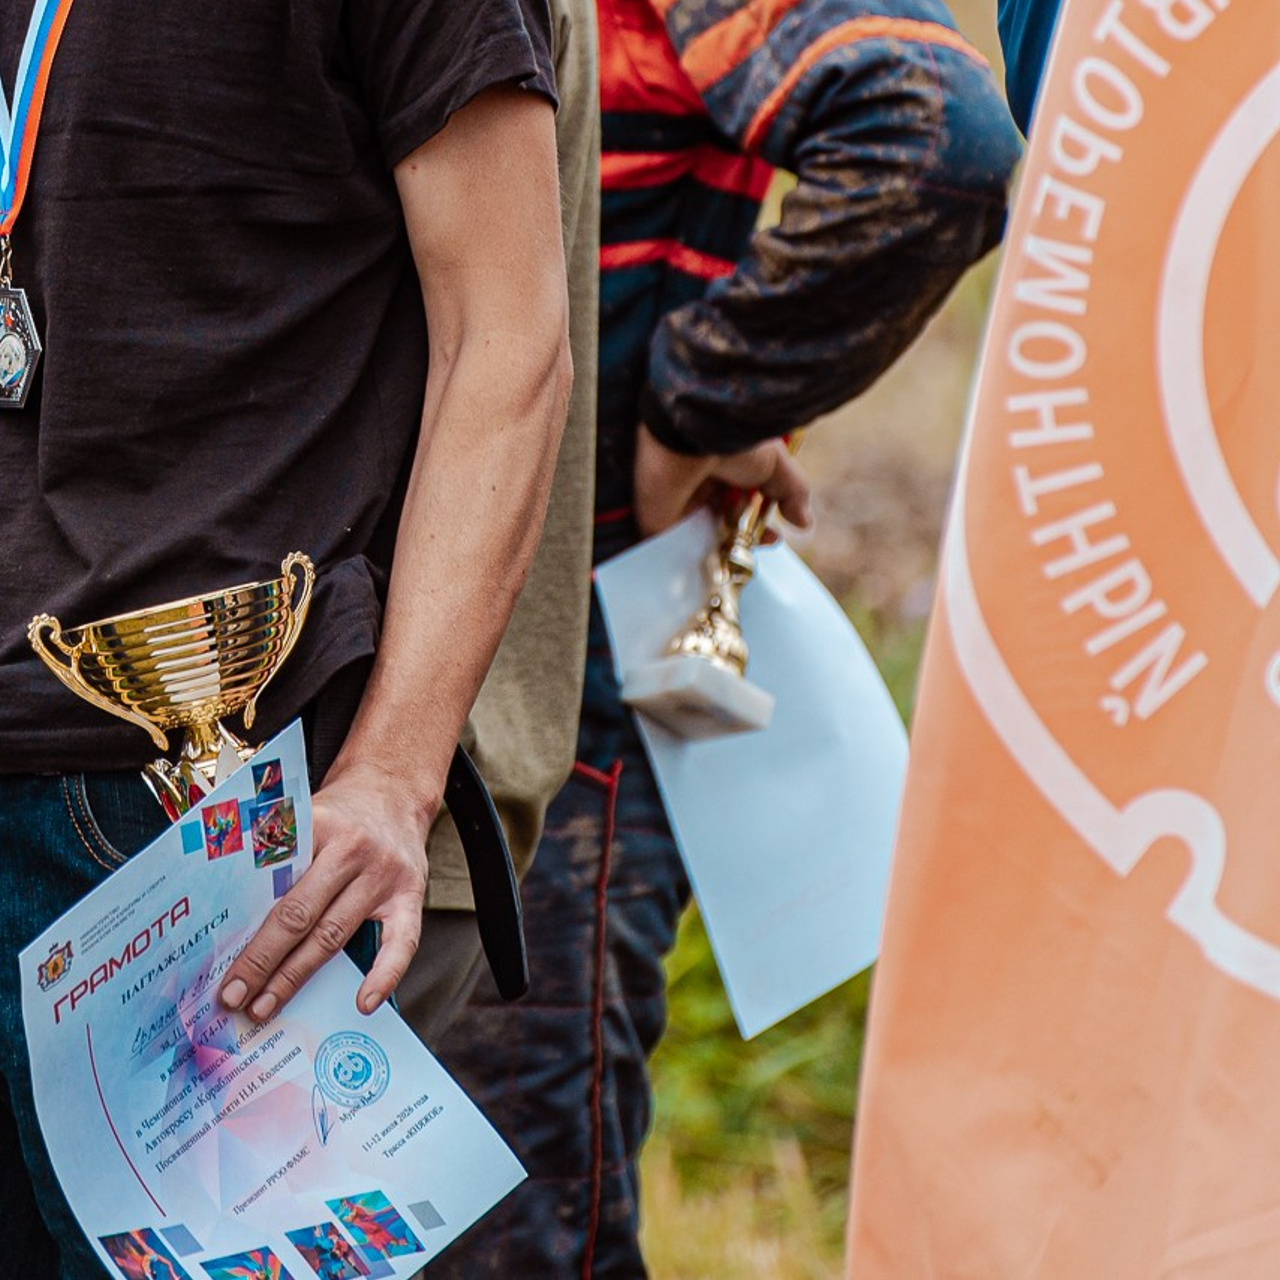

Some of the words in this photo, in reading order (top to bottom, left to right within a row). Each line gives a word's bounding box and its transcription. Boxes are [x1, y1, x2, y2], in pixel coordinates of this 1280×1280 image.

[53, 896, 190, 1025] ГРАМОТА
[121, 908, 229, 1005] НАГРАЖДАЕТСЯ
[184, 1002, 211, 1028] место
[167, 1046, 197, 1076] классе
[141, 1085, 193, 1130] Чемпионате
[191, 1043, 236, 1088] Рязанской
[144, 1107, 195, 1154] Автокроссу
[211, 1099, 242, 1124] памяти
